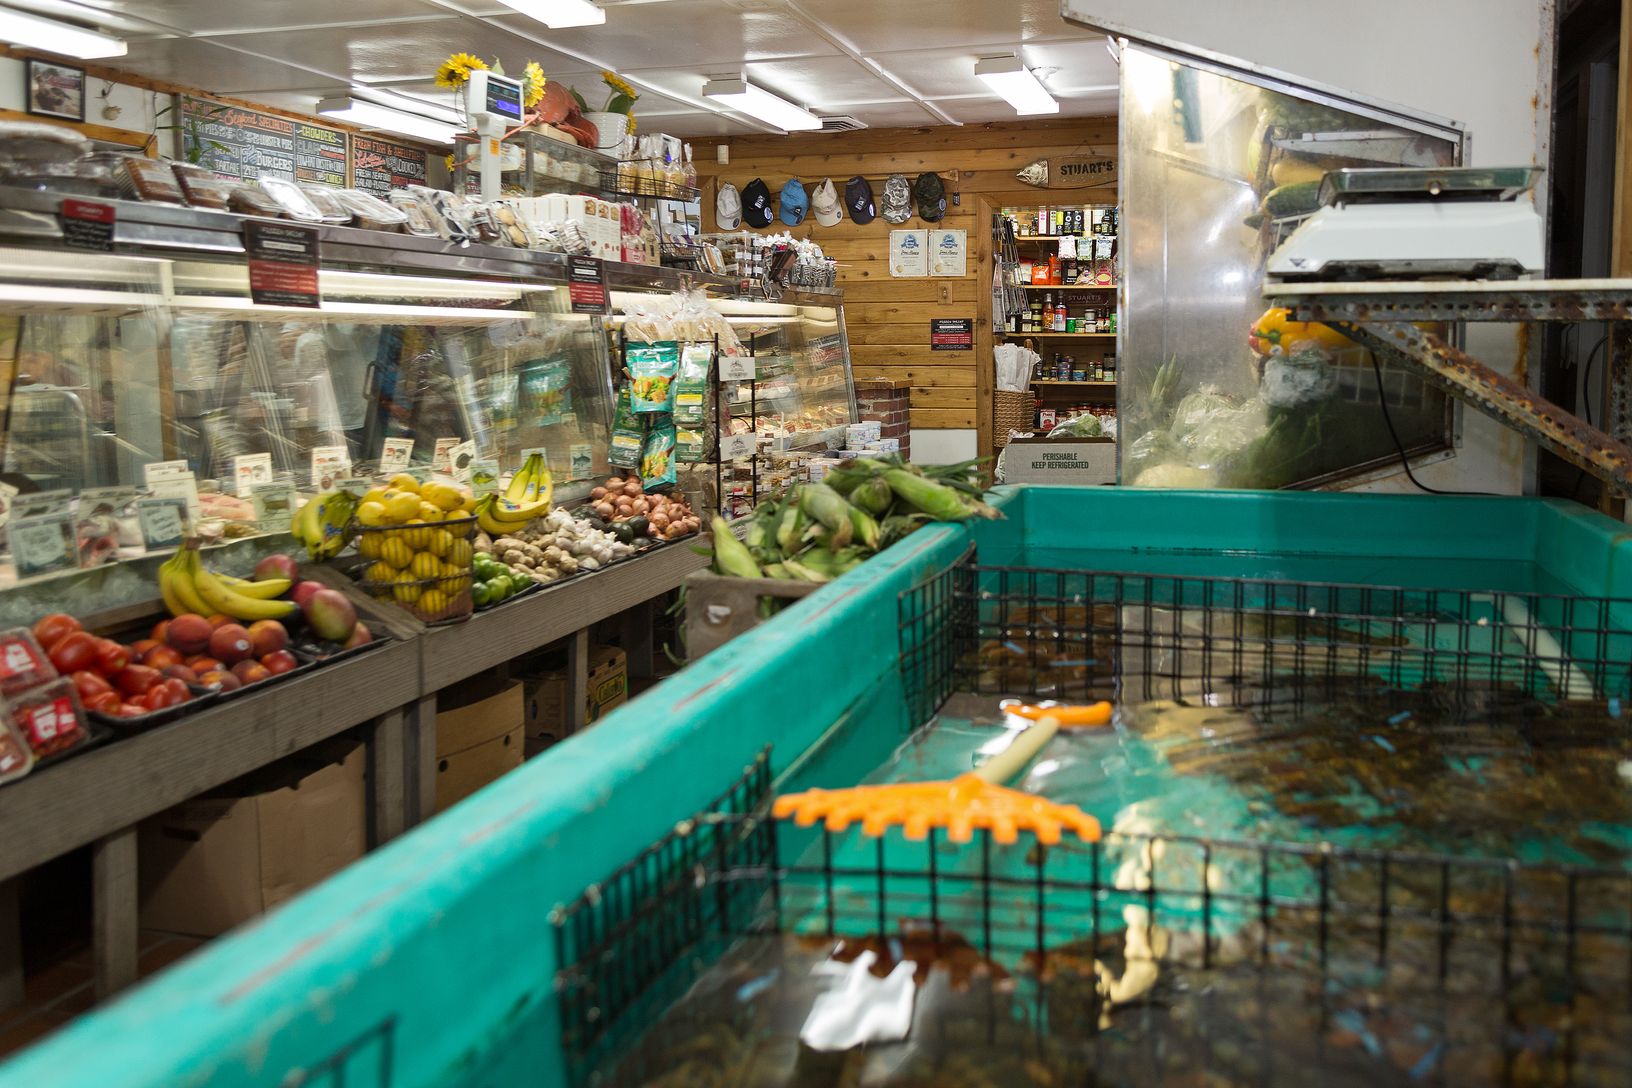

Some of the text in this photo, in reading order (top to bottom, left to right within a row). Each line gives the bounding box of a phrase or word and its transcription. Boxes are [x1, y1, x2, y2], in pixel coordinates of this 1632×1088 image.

[302, 126, 337, 142] CHOWDERS
[372, 141, 386, 153] FISH
[256, 150, 293, 172] BURGERS
[1061, 161, 1113, 175] STUART'S
[1031, 461, 1089, 469] KEEP REFRIGERATED
